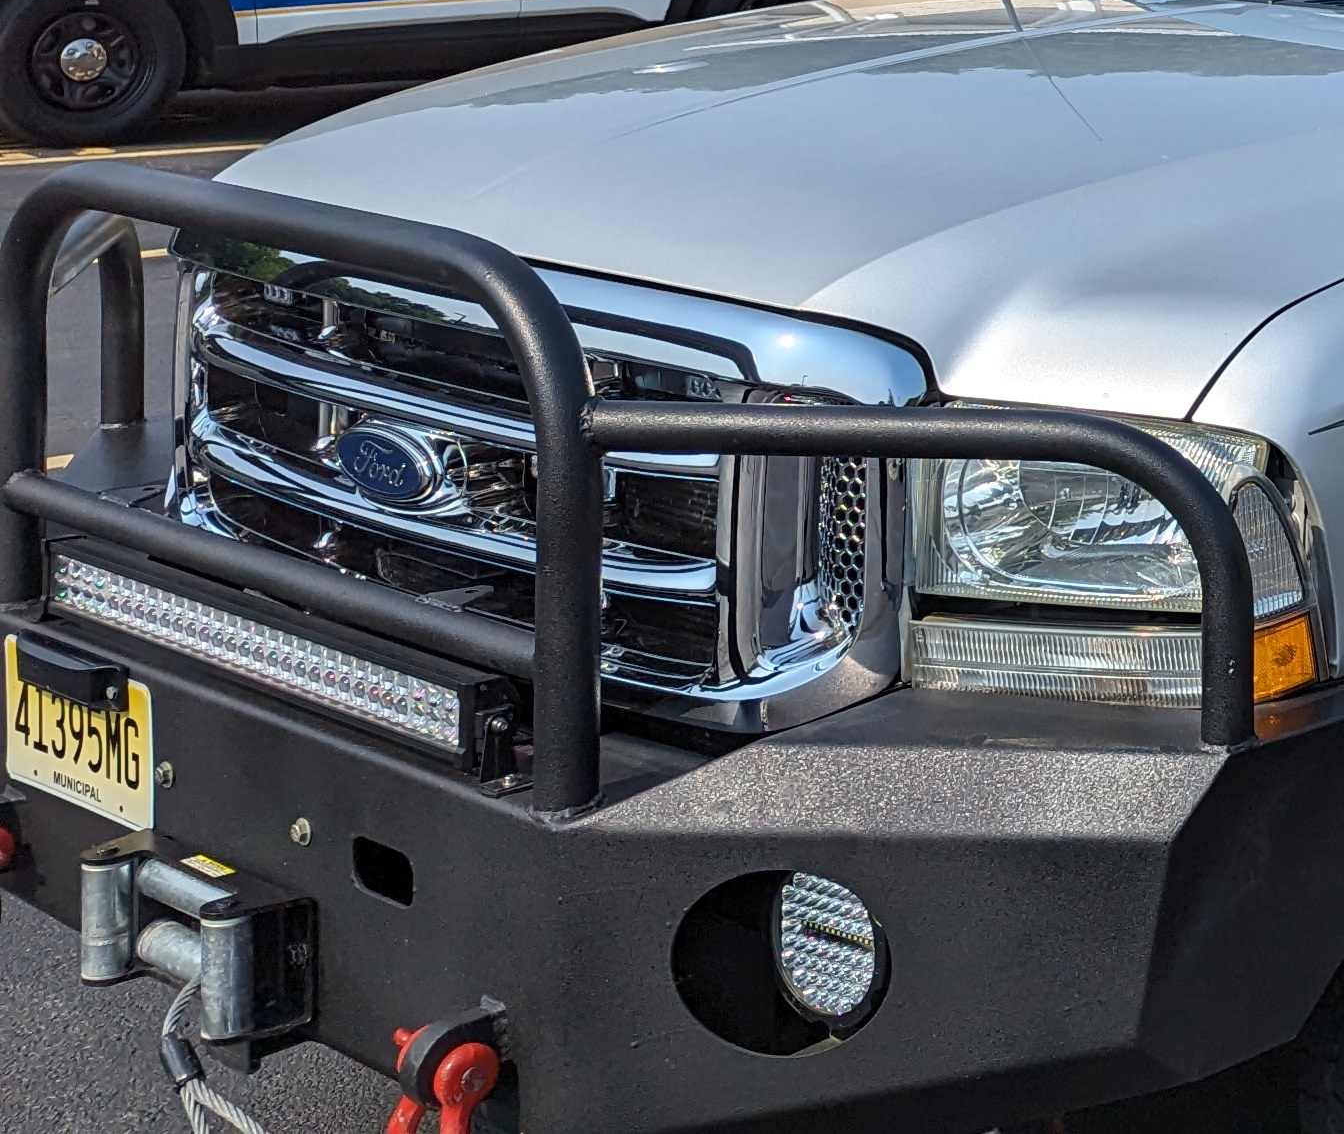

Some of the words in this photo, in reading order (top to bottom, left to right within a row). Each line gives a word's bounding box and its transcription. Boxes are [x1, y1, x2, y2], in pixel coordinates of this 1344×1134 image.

[353, 439, 407, 487] Ford
[15, 682, 140, 790] 41395MG
[53, 770, 102, 803] MUNICIPAL
